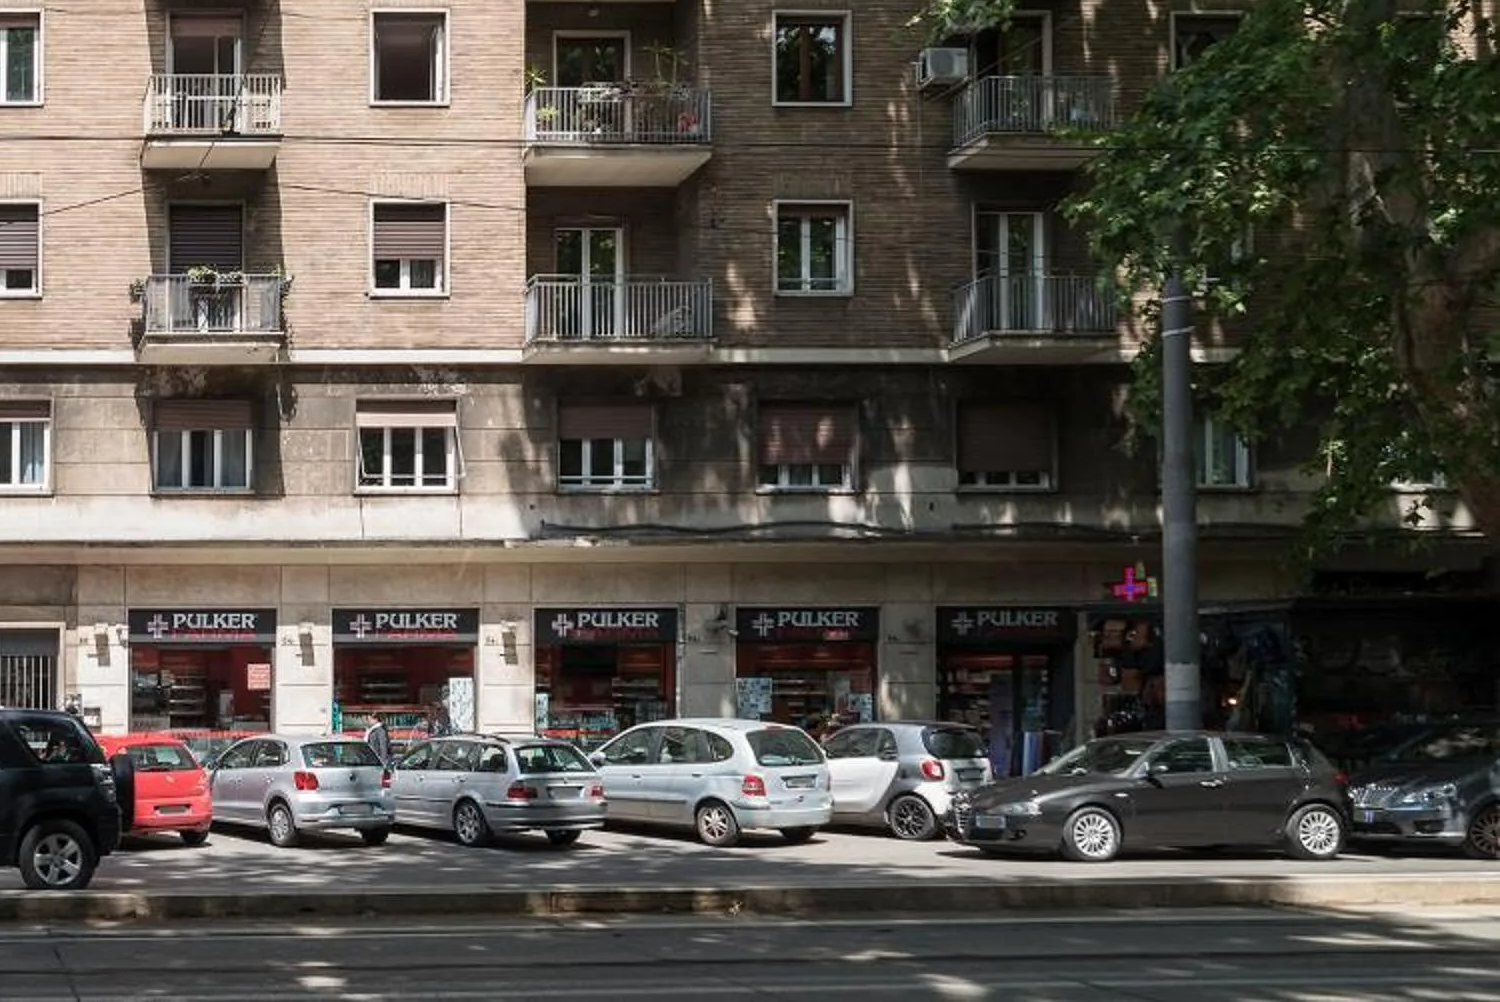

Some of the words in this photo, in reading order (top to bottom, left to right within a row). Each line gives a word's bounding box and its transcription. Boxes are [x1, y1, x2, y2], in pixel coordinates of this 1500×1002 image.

[173, 613, 256, 629] PULKER
[376, 613, 458, 629] PULKER
[577, 612, 659, 628] PULKER
[777, 611, 859, 627] PULKER
[977, 611, 1058, 627] PULKER
